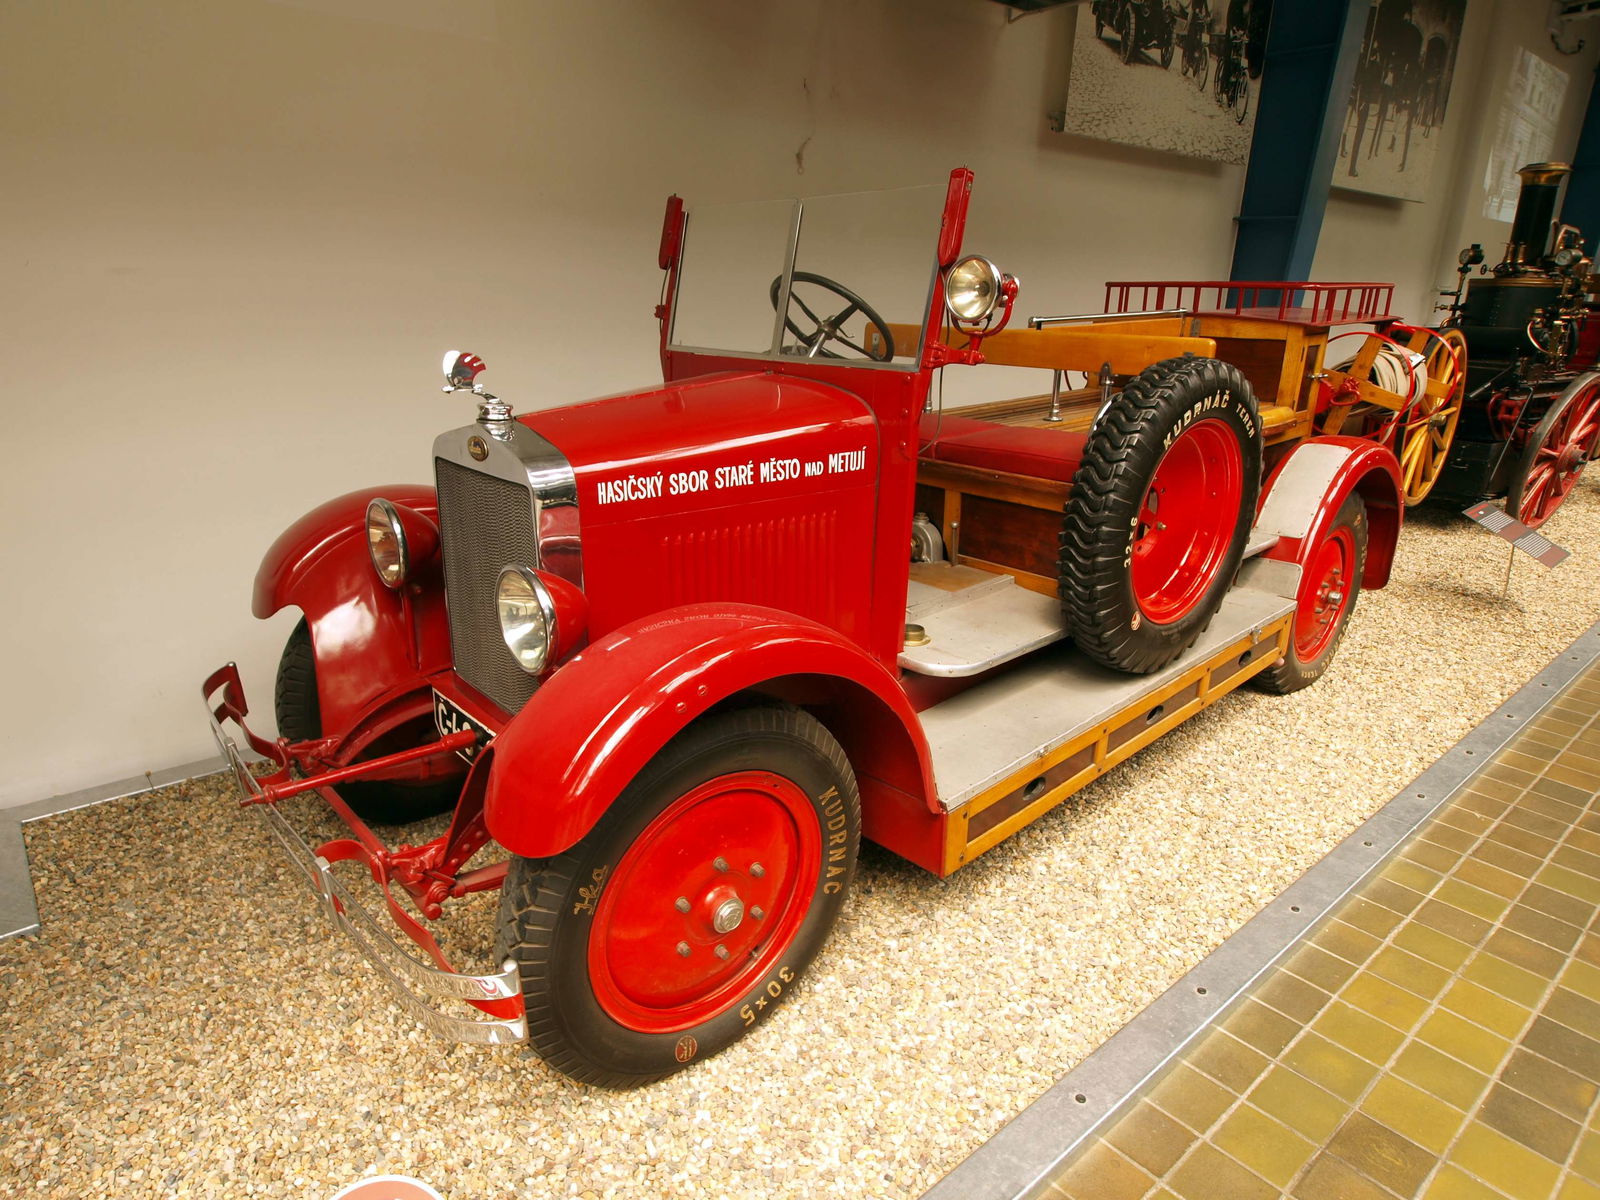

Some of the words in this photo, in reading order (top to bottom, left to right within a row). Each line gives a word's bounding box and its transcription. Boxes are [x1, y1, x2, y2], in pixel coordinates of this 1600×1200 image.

[1163, 389, 1230, 450] KUDRNÁČ
[597, 471, 664, 505] HASIČSKÝ
[669, 469, 709, 496] SBOR
[714, 460, 754, 490] STARÉ
[760, 457, 801, 484] MĚSTO
[804, 461, 824, 478] NAD
[828, 446, 867, 475] METUJÍ
